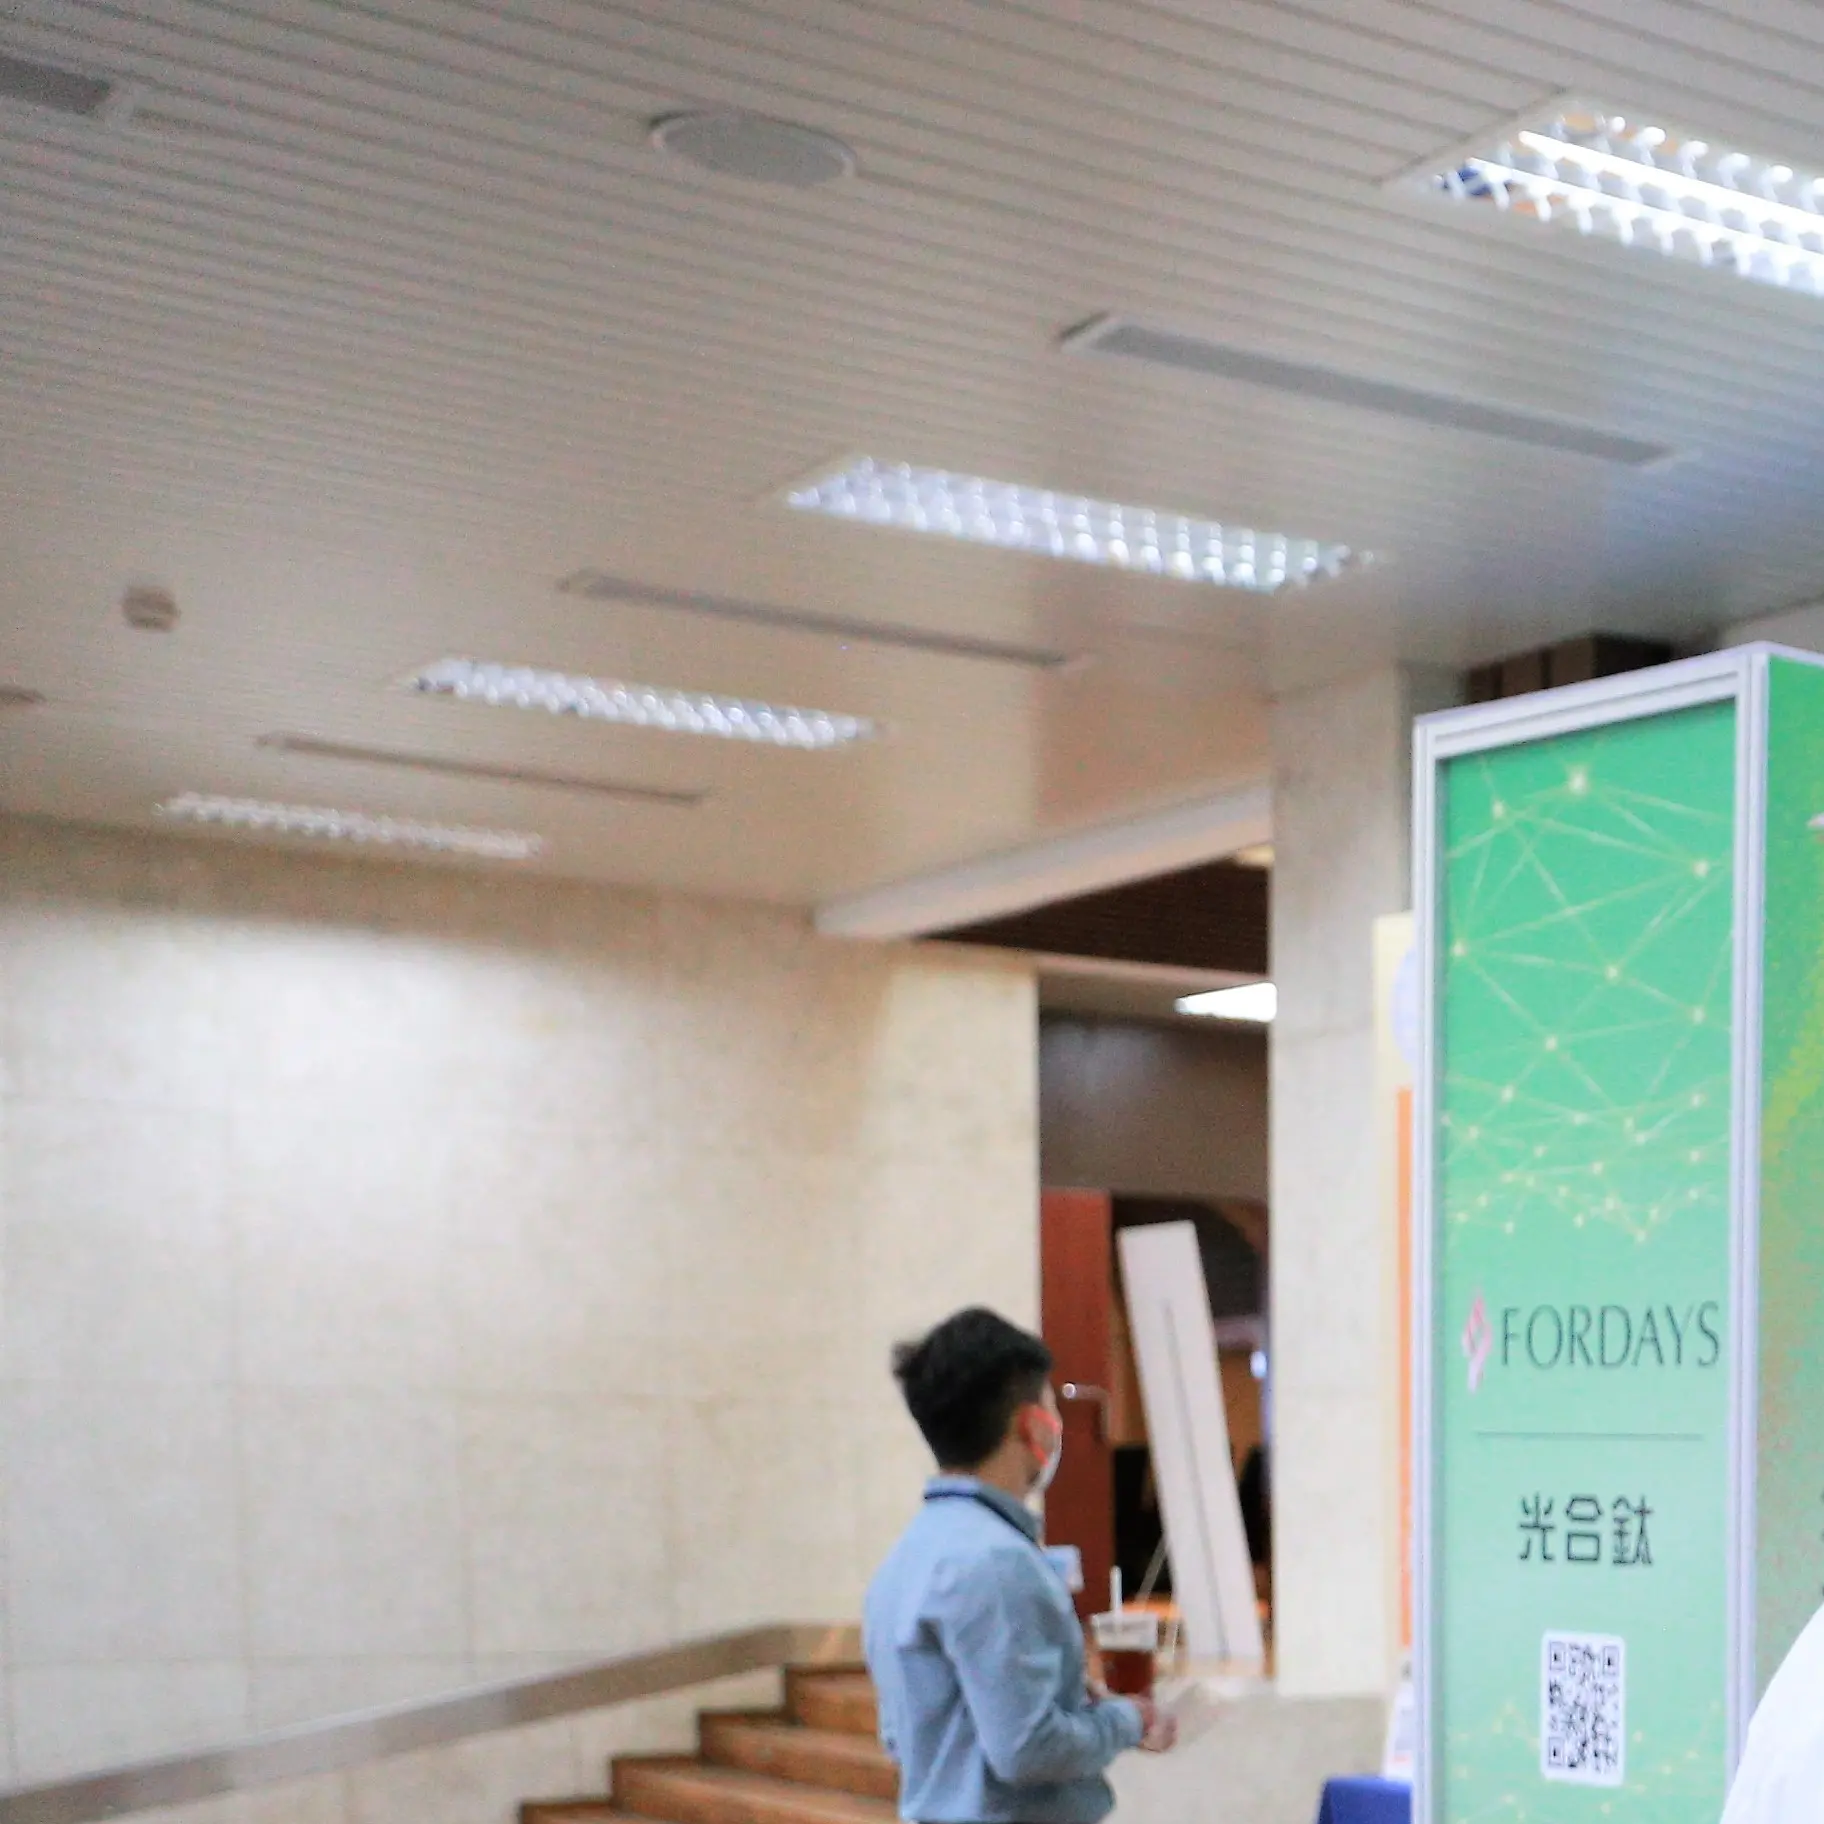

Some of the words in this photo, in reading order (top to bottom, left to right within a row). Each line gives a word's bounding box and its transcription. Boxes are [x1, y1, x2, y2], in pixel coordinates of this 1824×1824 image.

[1501, 1301, 1722, 1370] FORDAYS
[1518, 1493, 1656, 1568] 光合鈦
